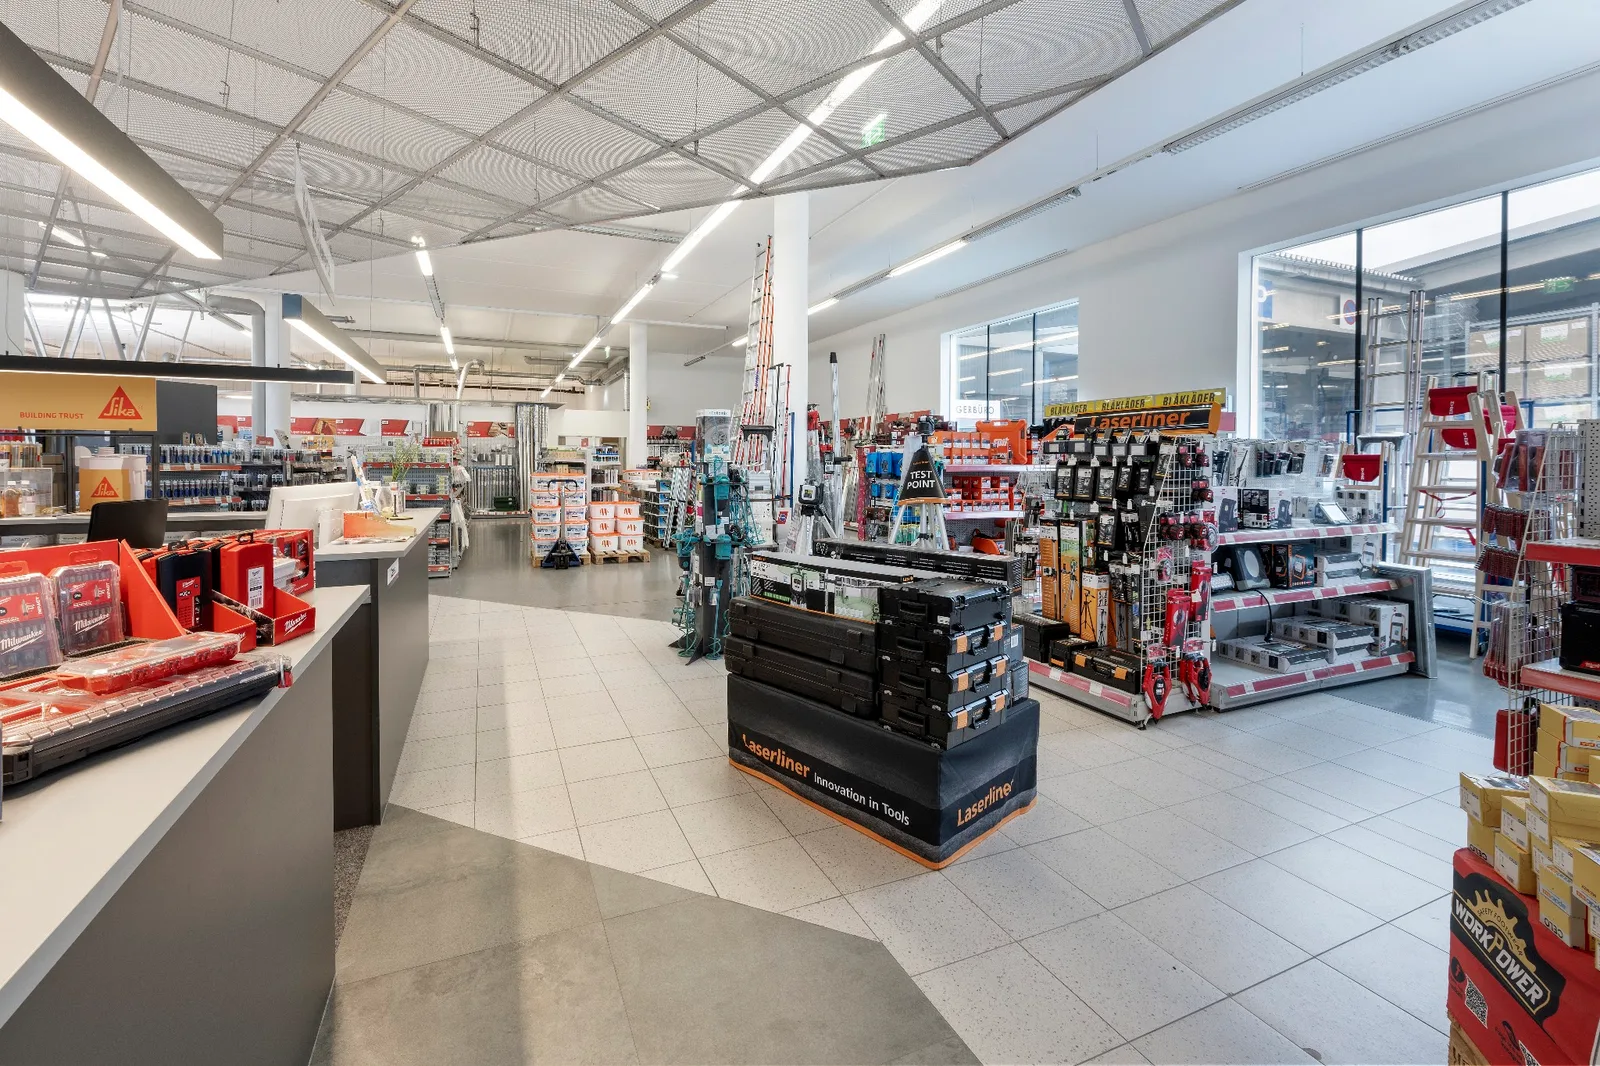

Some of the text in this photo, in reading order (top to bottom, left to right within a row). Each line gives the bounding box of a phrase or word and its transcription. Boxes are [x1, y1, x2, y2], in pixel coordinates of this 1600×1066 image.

[104, 397, 136, 416] Sika
[1090, 410, 1192, 429] Laserliner
[910, 470, 933, 480] TEST
[94, 482, 115, 496] Sika
[906, 480, 936, 490] POINT
[0, 630, 43, 650] Milwaukee
[742, 733, 911, 826] Laserliner Innovation in Tools
[1477, 907, 1524, 956] SAFETY FOOTWEAR
